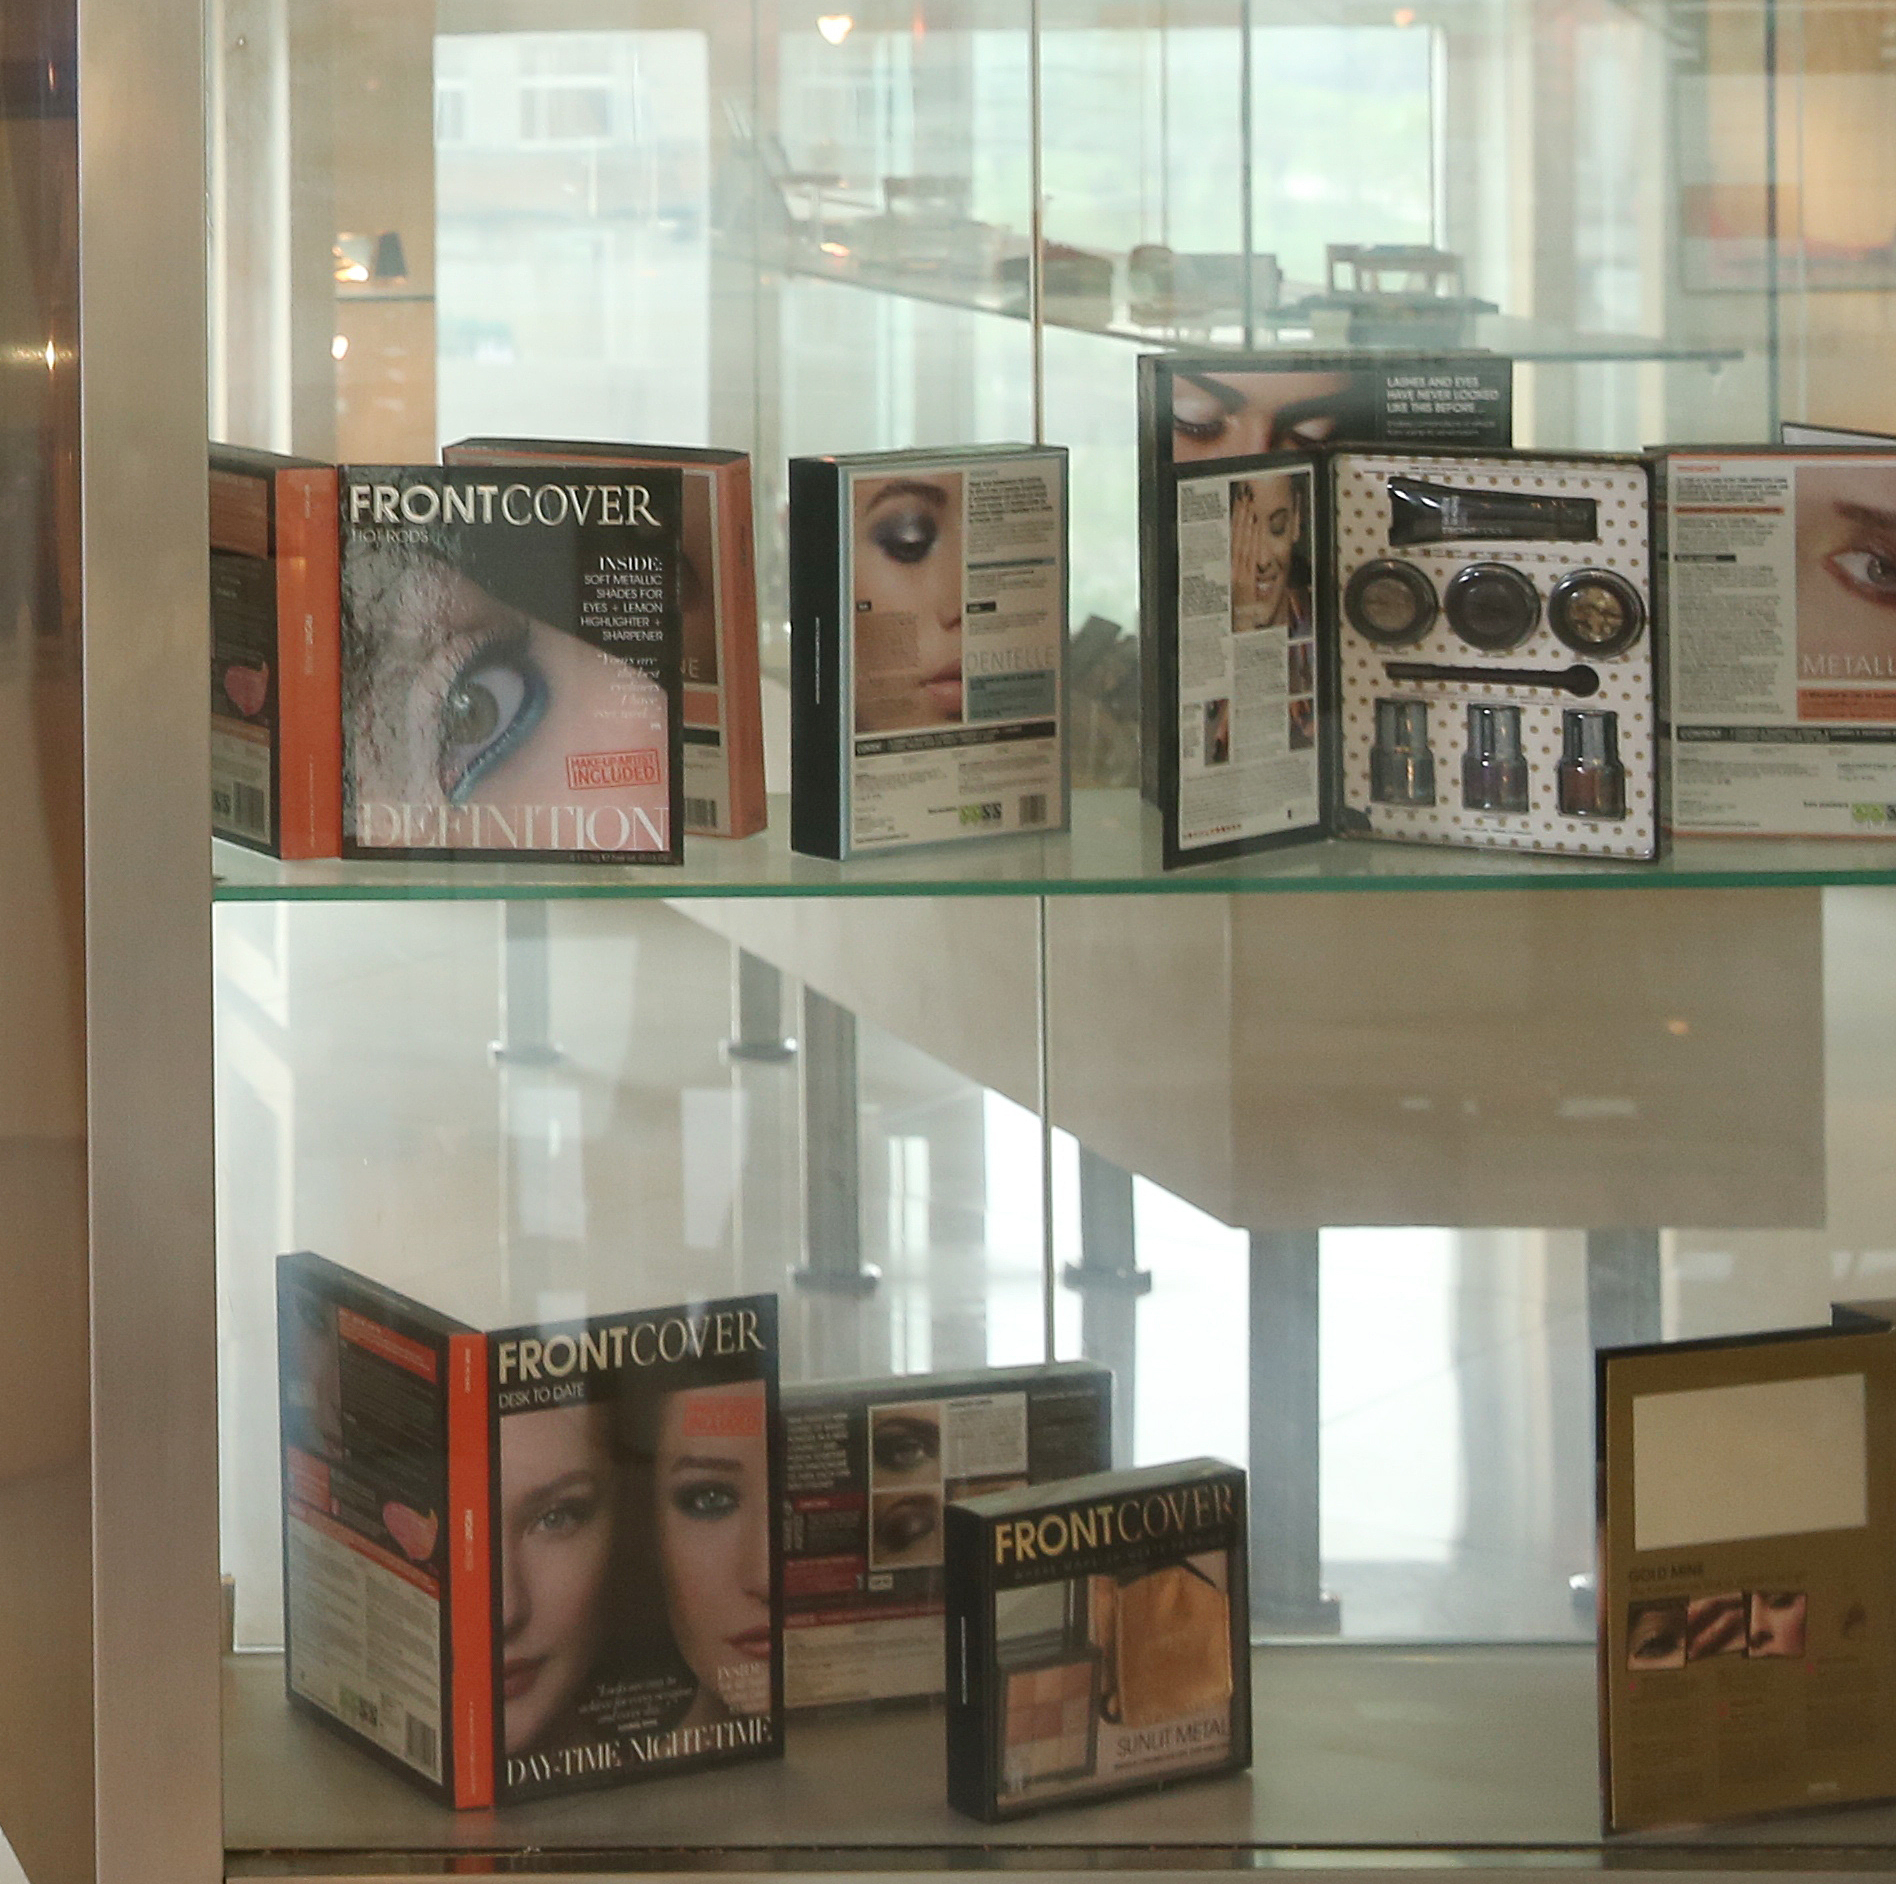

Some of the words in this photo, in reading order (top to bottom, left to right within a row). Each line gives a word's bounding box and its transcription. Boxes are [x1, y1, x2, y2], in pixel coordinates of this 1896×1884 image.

[1387, 377, 1425, 388] LASHES
[1428, 377, 1453, 387] AND
[1454, 377, 1479, 388] EYES
[1387, 389, 1414, 400] HAVE
[1416, 389, 1452, 400] NEVER
[1454, 389, 1499, 401] LOOKED
[350, 483, 661, 527] FRONTCOVER
[351, 529, 383, 543] HOT
[387, 529, 429, 544] RODS
[599, 556, 663, 571] INSIDE:
[584, 575, 609, 585] SOFT
[613, 574, 662, 585] METALLIC
[597, 589, 637, 600] SHADES
[640, 589, 663, 600] FOR
[583, 603, 607, 613] EYES
[623, 603, 663, 613] LEMON
[603, 631, 664, 641] SHARPENER
[966, 645, 1056, 674] DENTELLE
[574, 766, 655, 786] INCLUDED
[360, 803, 671, 850] DEFINITION
[499, 1311, 765, 1385] FRONTCOVER
[499, 1390, 529, 1409] DESK
[534, 1387, 549, 1401] TO
[554, 1382, 584, 1400] DATE
[996, 1484, 1232, 1564] FRONTCOVER
[1117, 1731, 1172, 1757] SUNLIT
[1175, 1722, 1230, 1745] METAL
[508, 1742, 622, 1786] DAY-TIME
[630, 1716, 773, 1762] NIGHT-TIME
